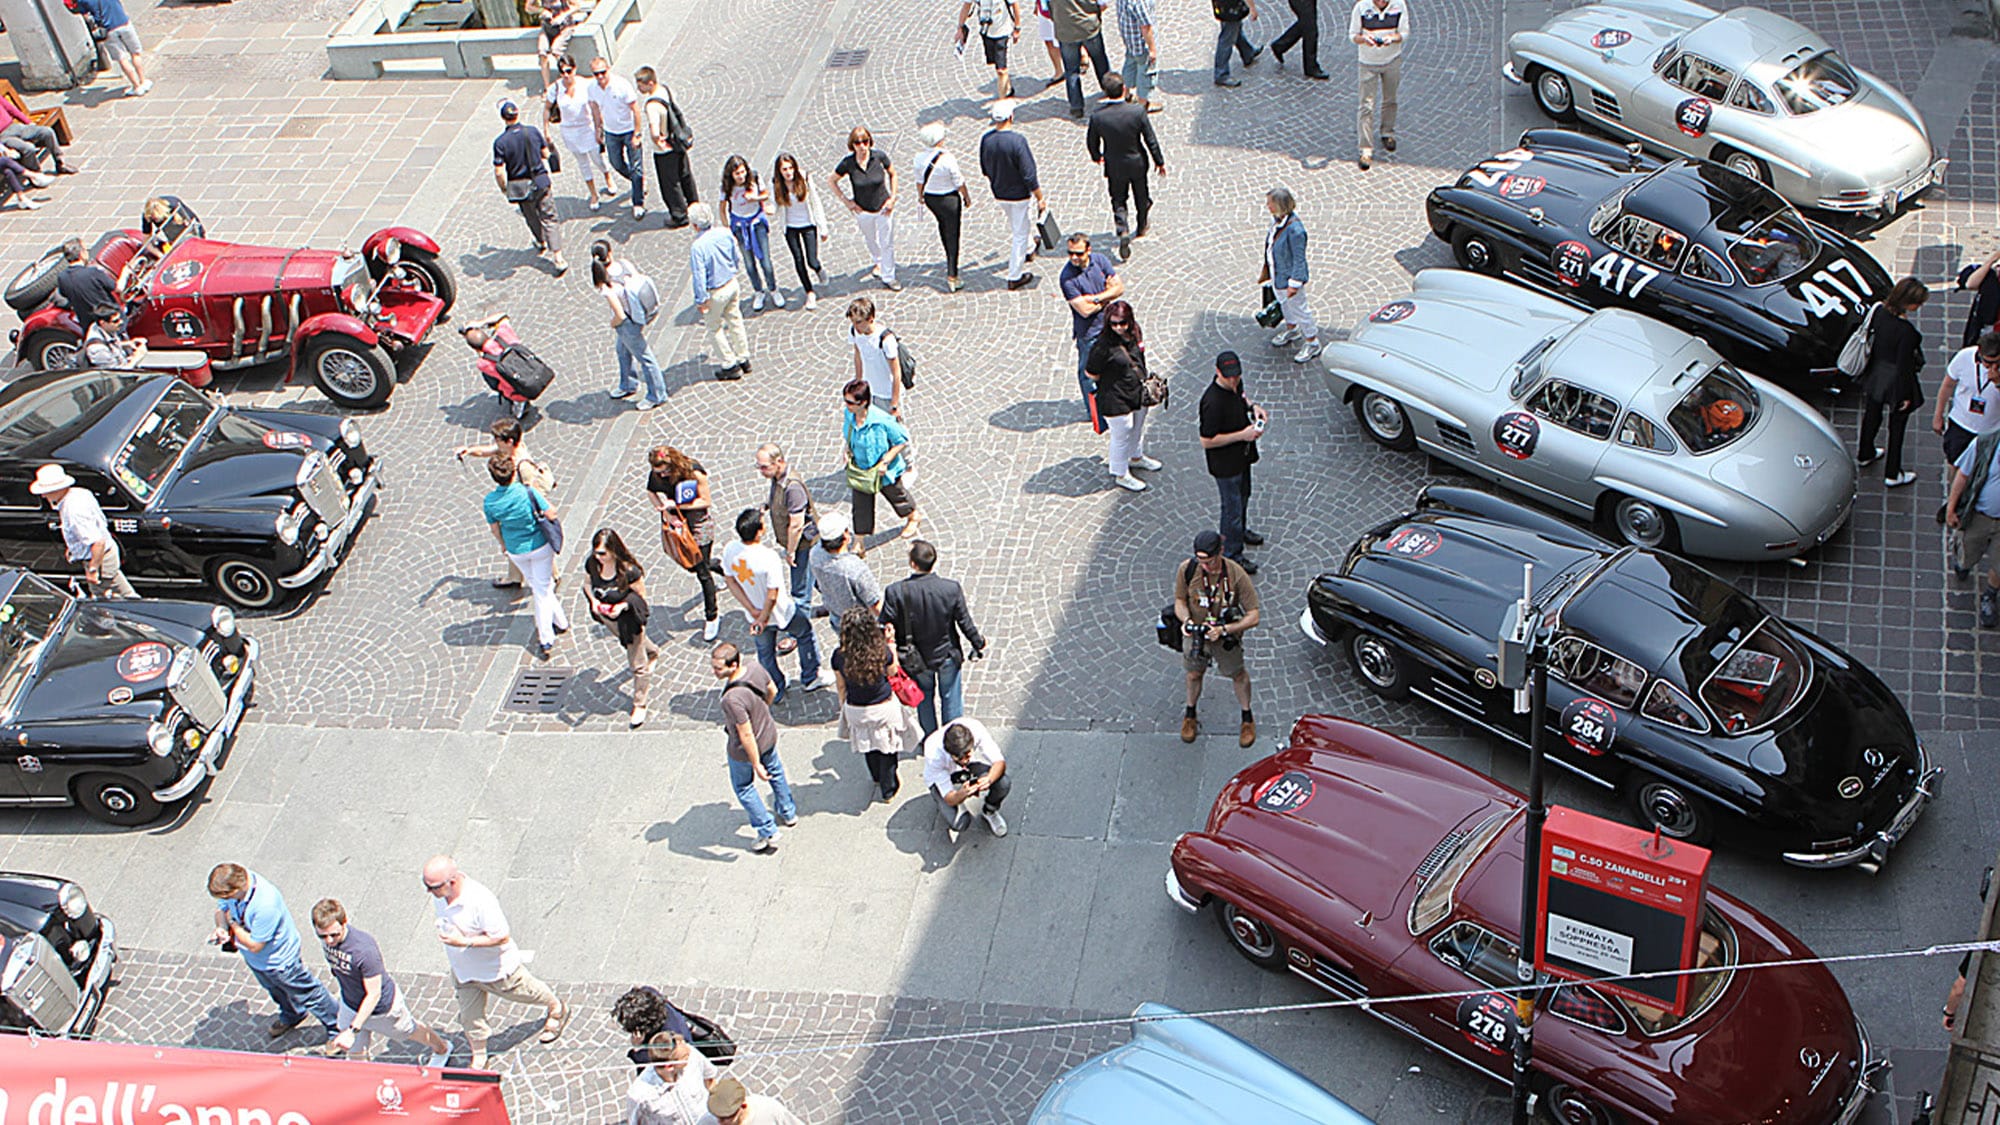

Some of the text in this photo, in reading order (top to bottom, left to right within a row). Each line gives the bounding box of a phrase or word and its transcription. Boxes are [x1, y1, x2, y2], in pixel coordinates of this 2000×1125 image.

[1682, 107, 1707, 127] 267
[1559, 256, 1584, 276] 271
[1589, 251, 1660, 299] 417
[1799, 258, 1874, 318] 417
[176, 322, 194, 335] 44
[1501, 424, 1532, 447] 277
[1571, 715, 1605, 742] 284
[1266, 780, 1299, 806] 278
[1604, 861, 1666, 887] ZANARDELLI
[1559, 931, 1620, 955] SOPPRESSA
[1566, 925, 1615, 945] FERMATA
[1468, 1010, 1507, 1042] 278
